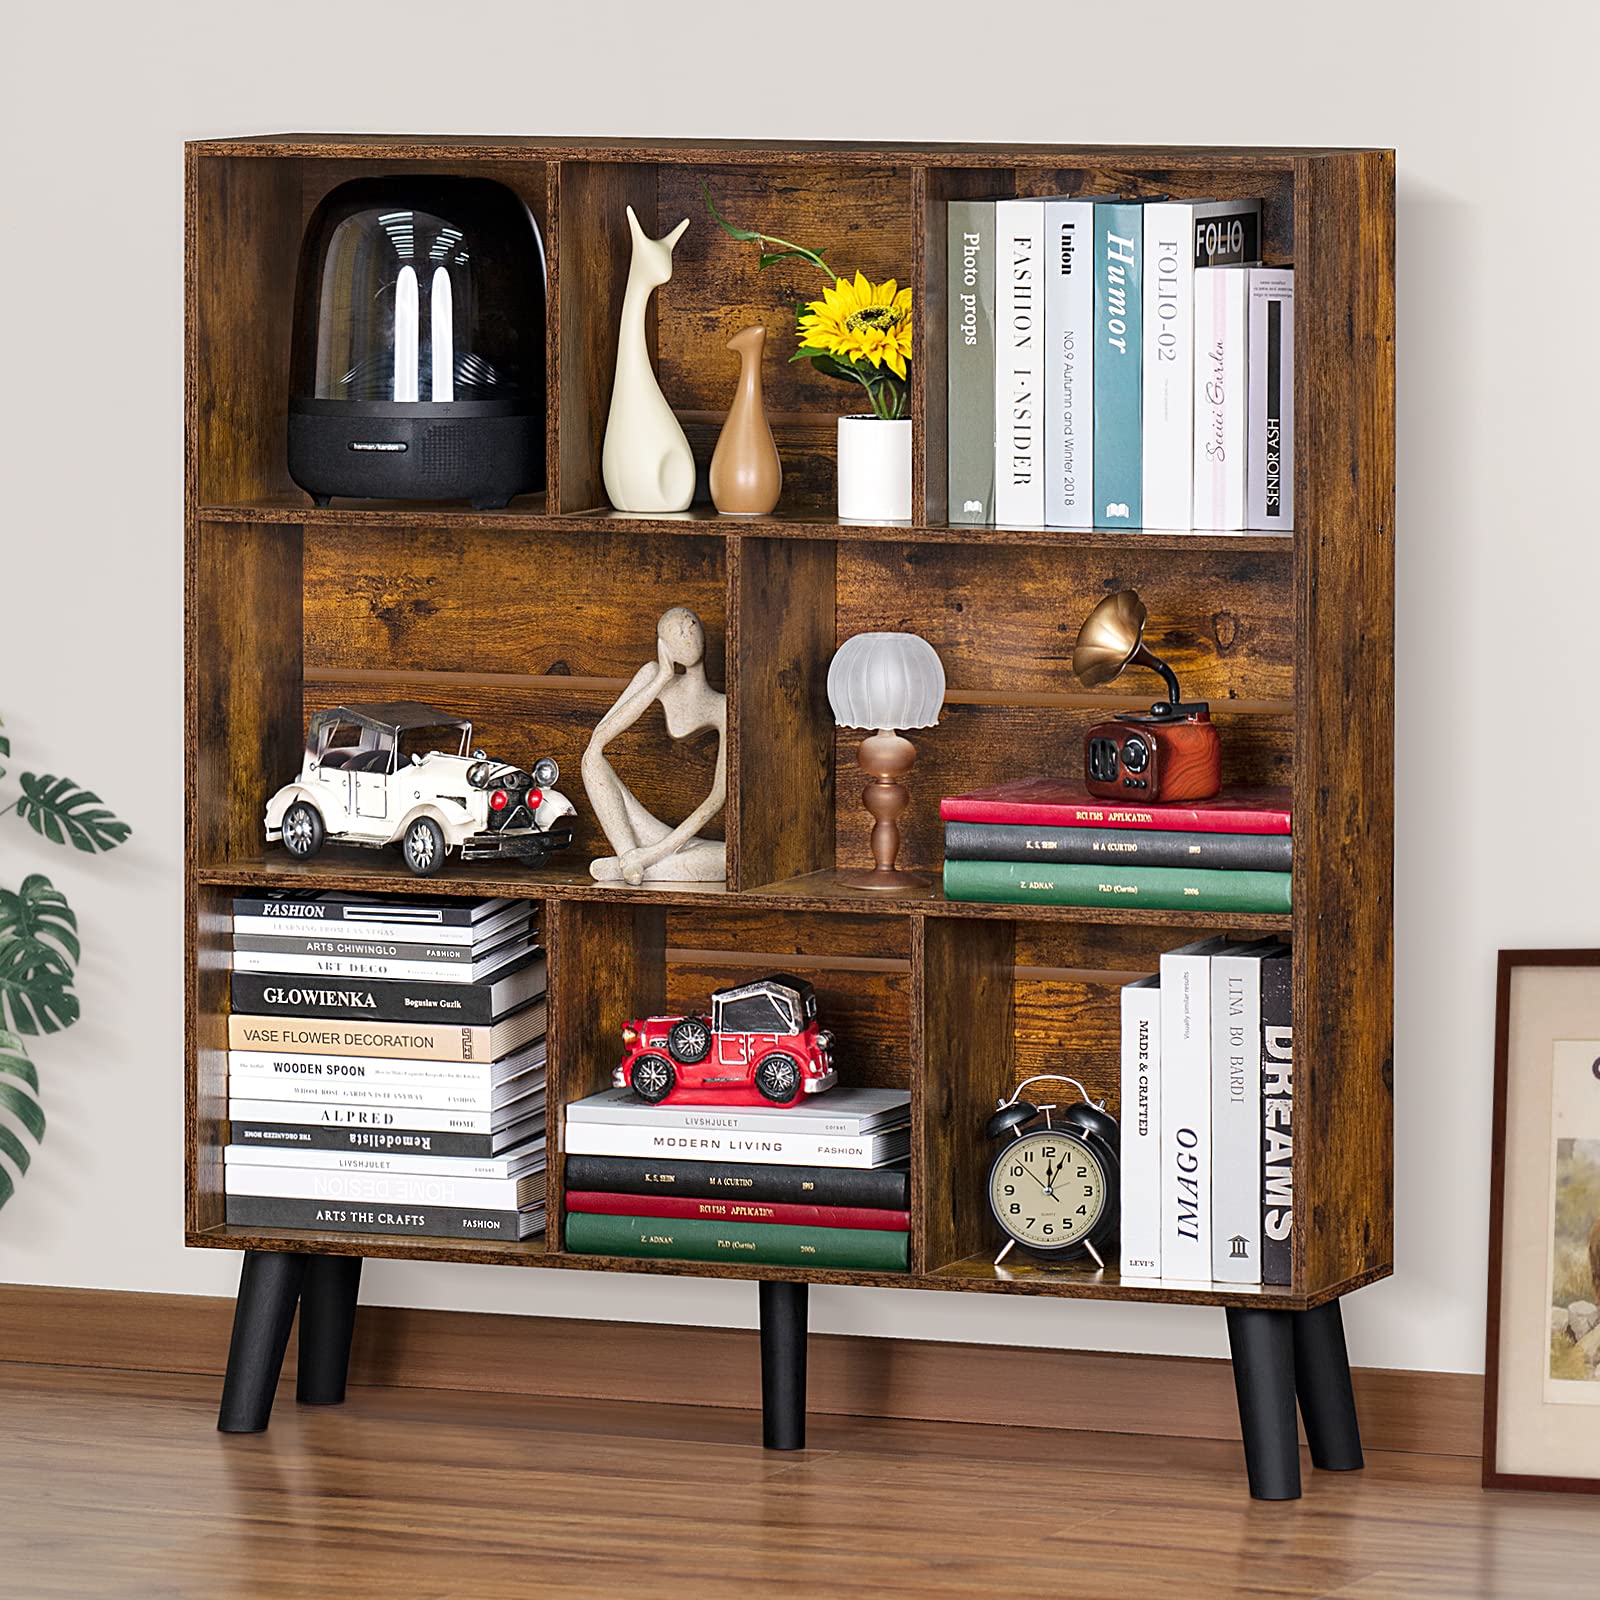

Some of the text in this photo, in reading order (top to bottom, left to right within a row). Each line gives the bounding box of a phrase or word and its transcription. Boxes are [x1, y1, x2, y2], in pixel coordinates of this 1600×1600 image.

[1196, 220, 1243, 257] FOLIO
[1061, 223, 1075, 275] Union
[960, 232, 980, 346] Photo props
[1013, 237, 1032, 349] FASHION
[1106, 230, 1135, 355] Humor
[1157, 241, 1178, 362] FOLIO-02
[1063, 362, 1074, 409] Autumn
[1063, 412, 1074, 435] and
[1063, 437, 1074, 473] Winter
[1266, 418, 1280, 506] SENIOR ASH
[1064, 477, 1075, 506] 2018
[262, 903, 326, 918] FASHION
[306, 942, 397, 956] ARTS CHIWINGLO
[426, 950, 461, 958] FASHION
[317, 961, 388, 974] ART DECO
[263, 987, 377, 1008] GŁOWIENKA
[439, 999, 462, 1009] Guzik
[243, 1029, 434, 1049] VASE FLOWER DECORATION
[1228, 978, 1245, 1103] LINA BO BARDI
[273, 1062, 323, 1075] WOODEN
[326, 1065, 366, 1077] SPOON
[1138, 1020, 1149, 1137] MADE & CRAFTED
[321, 1109, 394, 1125] ALPRED
[685, 1117, 738, 1127] LIVSHJULET
[449, 1120, 476, 1129] HOME
[263, 1131, 298, 1141] ORGANIZED
[299, 1133, 312, 1141] THE
[1264, 1025, 1293, 1241] DREAMS
[350, 1132, 432, 1150] Remodelista
[653, 1137, 783, 1152] MODERN LIVING
[817, 1146, 863, 1155] FASHION
[1024, 1151, 1034, 1162] 11
[1042, 1147, 1056, 1158] 12
[1067, 1152, 1071, 1163] 1
[339, 1159, 391, 1169] LIVSHJULET
[1010, 1165, 1024, 1177] 10
[1077, 1166, 1087, 1178] 2
[396, 1180, 457, 1201] HOME
[1004, 1185, 1015, 1196] 9
[1083, 1185, 1093, 1197] 3
[1176, 1128, 1198, 1242] IMAGO
[1009, 1203, 1021, 1215] 8
[1075, 1204, 1087, 1216] 4
[315, 1210, 425, 1226] ARTS THE CRAFTS
[462, 1219, 500, 1229] FASHION
[1026, 1218, 1036, 1229] 7
[1062, 1218, 1073, 1230] 5
[1043, 1224, 1054, 1235] 6
[1129, 1260, 1155, 1268] LEVI'S
